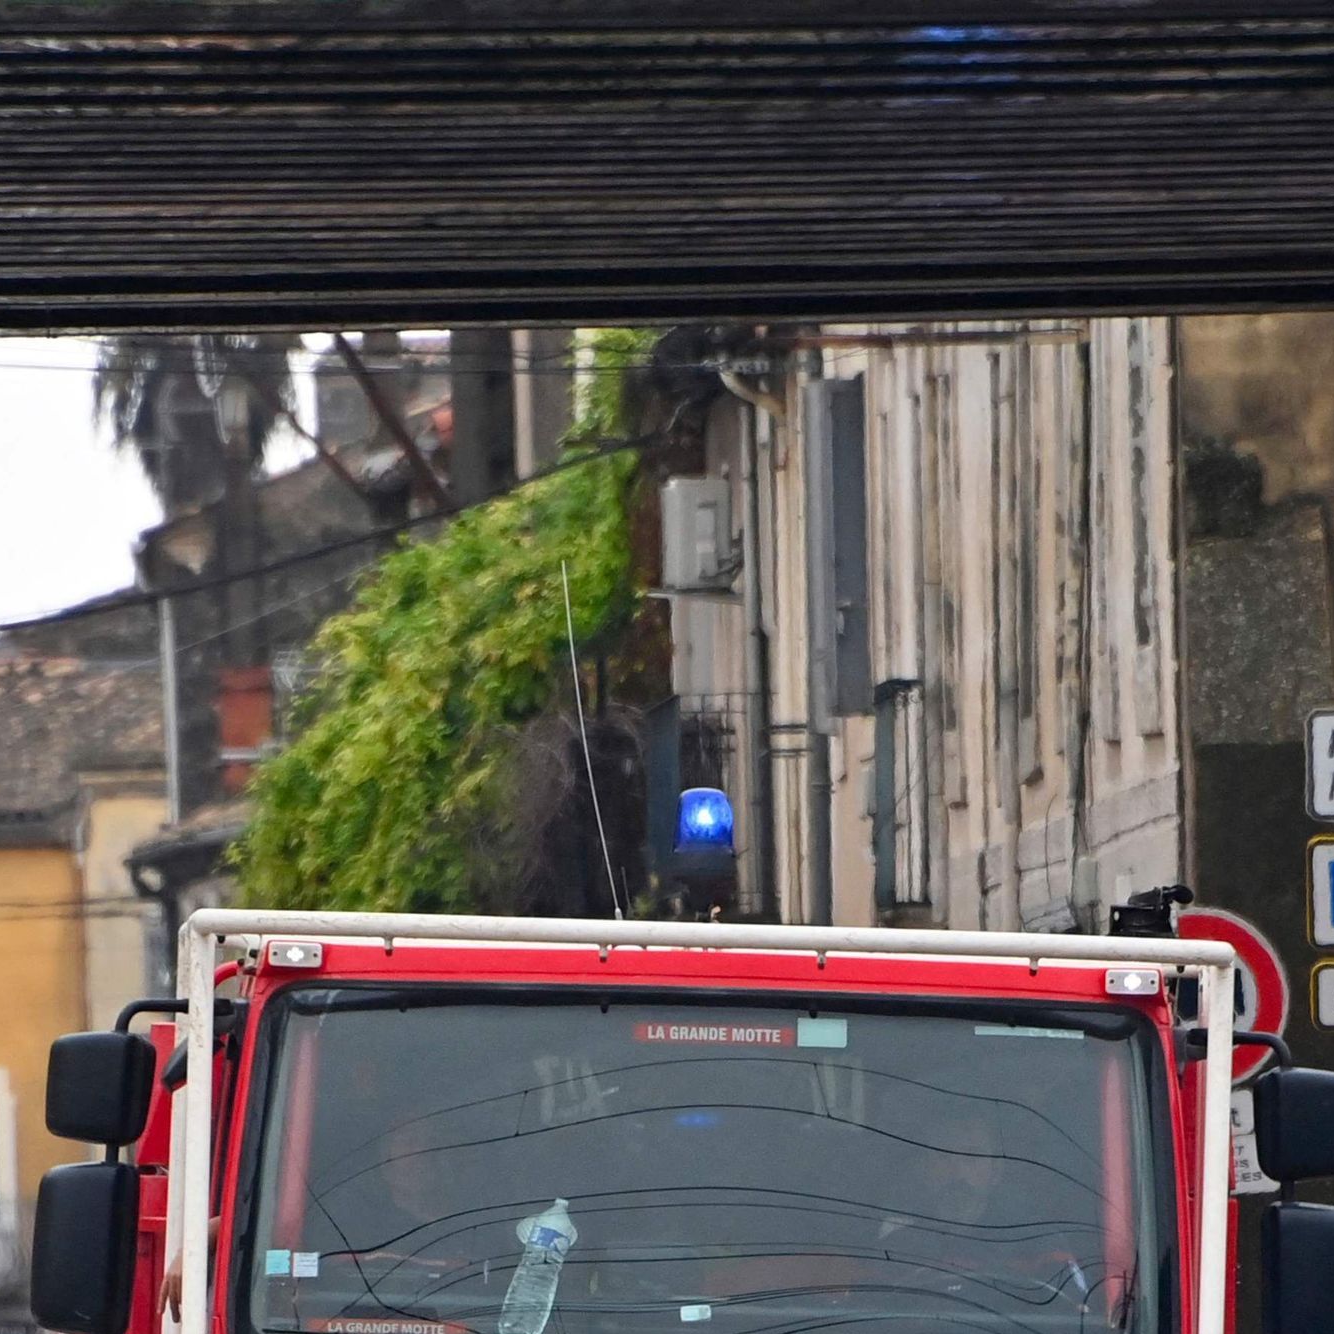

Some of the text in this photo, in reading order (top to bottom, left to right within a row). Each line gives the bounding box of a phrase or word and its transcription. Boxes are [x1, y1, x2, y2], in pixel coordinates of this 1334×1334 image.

[647, 1025, 781, 1043] LA GRANDE MOTTE
[327, 1322, 343, 1333] LA
[401, 1324, 445, 1334] MOTTE
